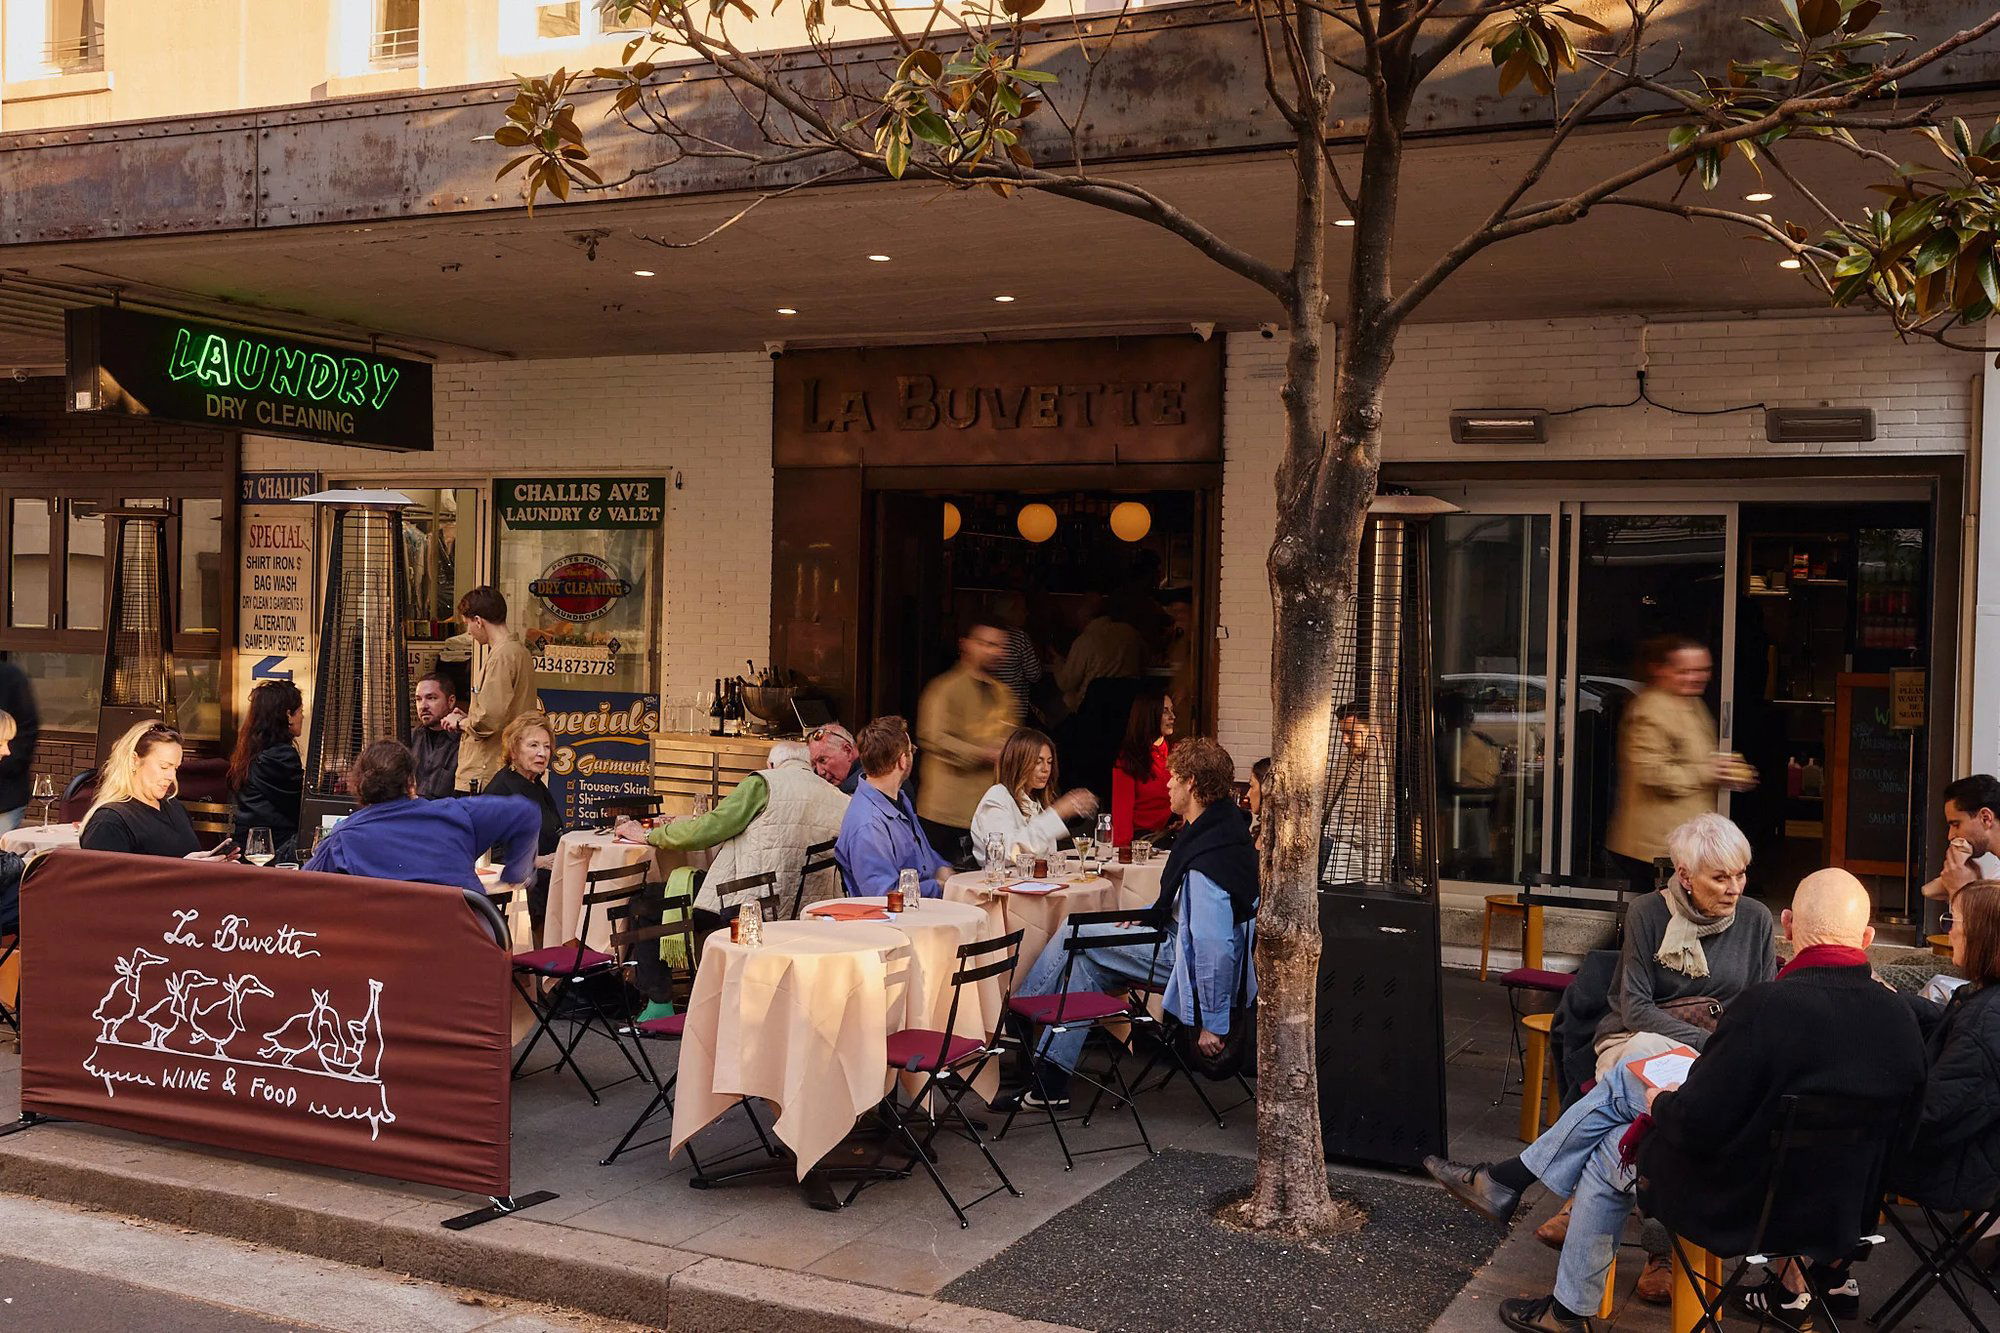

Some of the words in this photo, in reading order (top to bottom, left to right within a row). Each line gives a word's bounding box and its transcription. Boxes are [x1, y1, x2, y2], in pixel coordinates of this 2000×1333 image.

[169, 328, 400, 410] LAUNDRY
[802, 377, 874, 433] LA
[896, 374, 1185, 432] BUVETTE
[206, 394, 247, 421] DRY
[256, 401, 355, 434] CLEANING
[243, 480, 254, 499] 37
[258, 477, 310, 499] CHALLIS
[514, 483, 600, 502] CHALLIS
[608, 483, 649, 501] AVE
[506, 507, 583, 521] LAUNDRY
[588, 507, 601, 522] &
[607, 507, 660, 521] VALET
[246, 555, 271, 570] SHIRT
[552, 557, 579, 571] POTTS
[583, 556, 608, 571] POINT
[254, 575, 271, 590] BAG
[273, 576, 297, 591] WASH
[537, 581, 560, 595] DRY
[564, 581, 623, 596] CLEANING
[242, 595, 253, 608] DRY
[253, 596, 268, 610] CLEAN
[273, 597, 299, 611] GARMENTS
[550, 605, 608, 620] LAUNDROMAT
[254, 615, 297, 631] ALTERATION
[244, 634, 262, 650] SAME
[264, 634, 277, 650] DAY
[278, 636, 304, 652] SERVICE
[537, 697, 658, 735] pecials
[552, 746, 576, 776] 3
[577, 753, 651, 776] Garments
[579, 780, 651, 795] Trousers/Skirts
[163, 909, 204, 948] La
[212, 914, 321, 958] Buvette
[162, 1067, 211, 1090] WINE
[222, 1067, 238, 1095] &
[250, 1078, 297, 1106] FOOD
